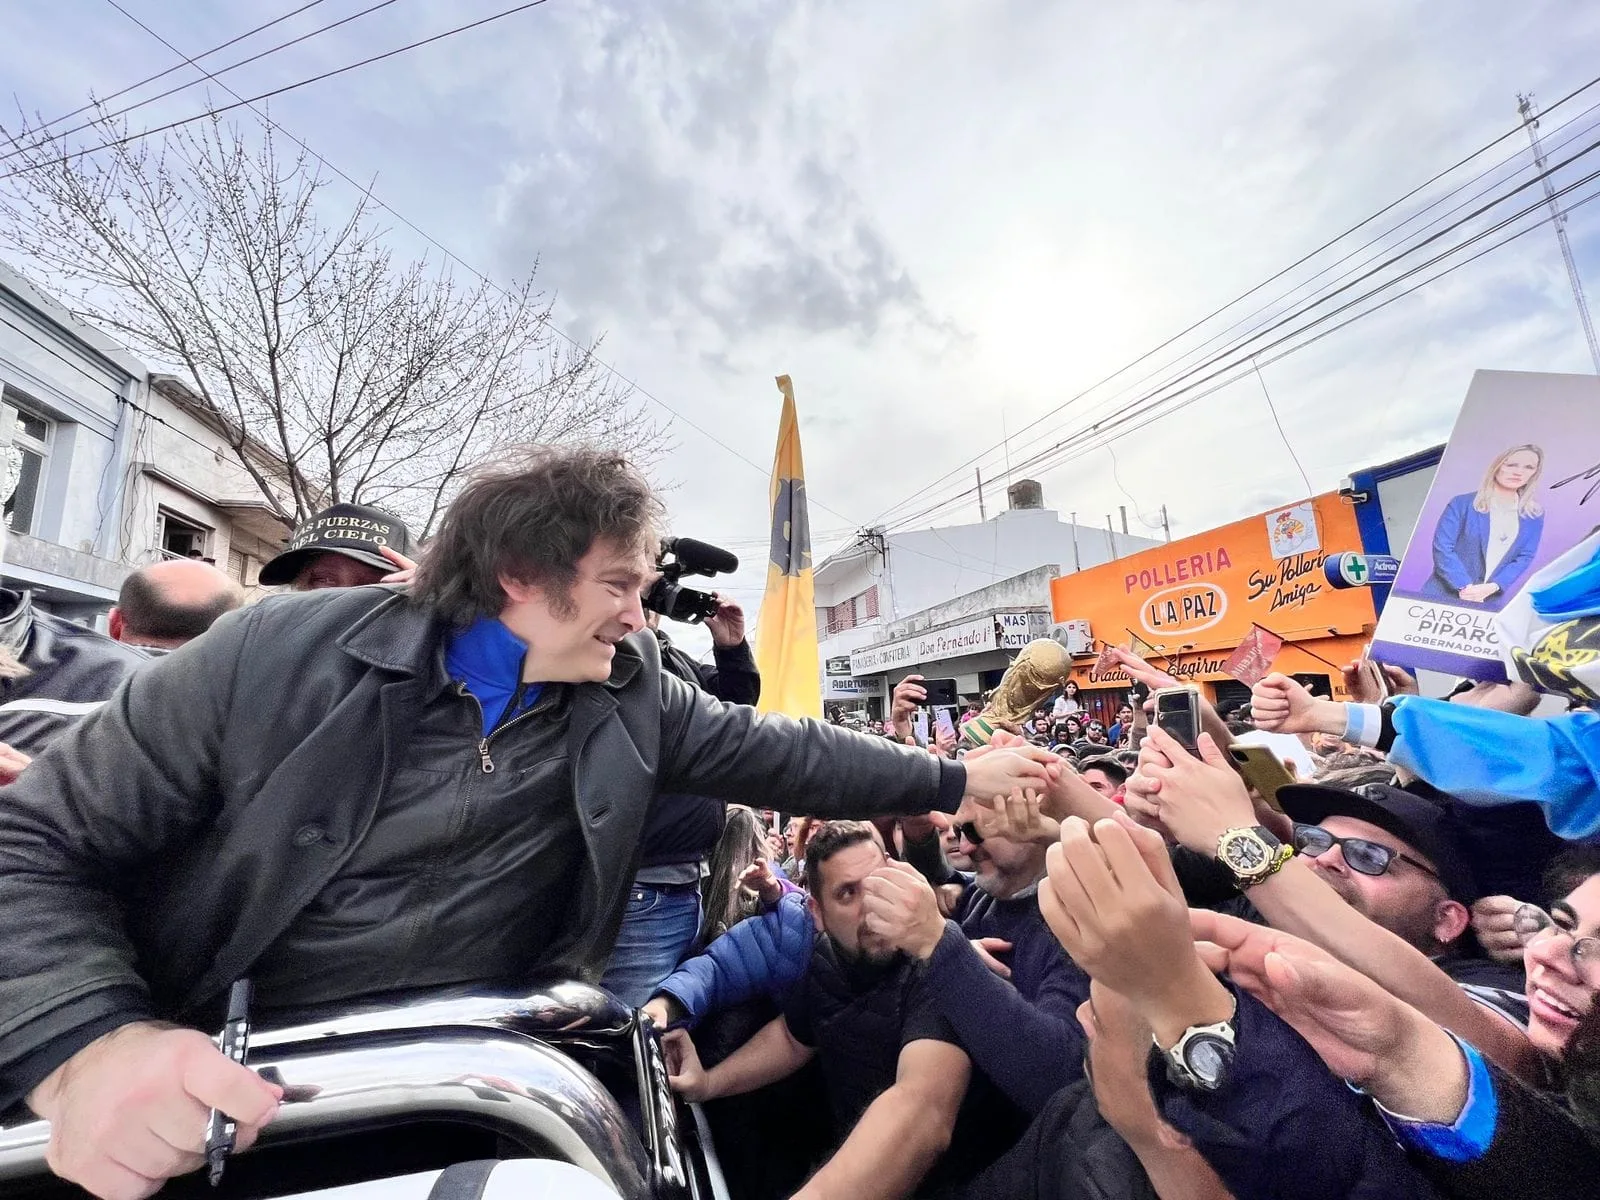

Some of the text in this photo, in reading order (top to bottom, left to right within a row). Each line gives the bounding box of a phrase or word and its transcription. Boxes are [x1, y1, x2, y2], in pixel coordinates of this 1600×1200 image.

[317, 516, 390, 535] FUERZAS
[291, 529, 388, 550] DEL CIELO
[1125, 547, 1232, 594] POLLERIA
[1248, 550, 1330, 601] Su Pollerí
[1151, 592, 1217, 626] LA PAZ
[1270, 582, 1322, 612] Amiga
[1408, 605, 1495, 631] CAROLI
[920, 641, 935, 656] Don
[937, 630, 981, 652] Fernando
[1404, 634, 1500, 657] GOBERNADORA
[832, 679, 880, 689] ABERTURAS
